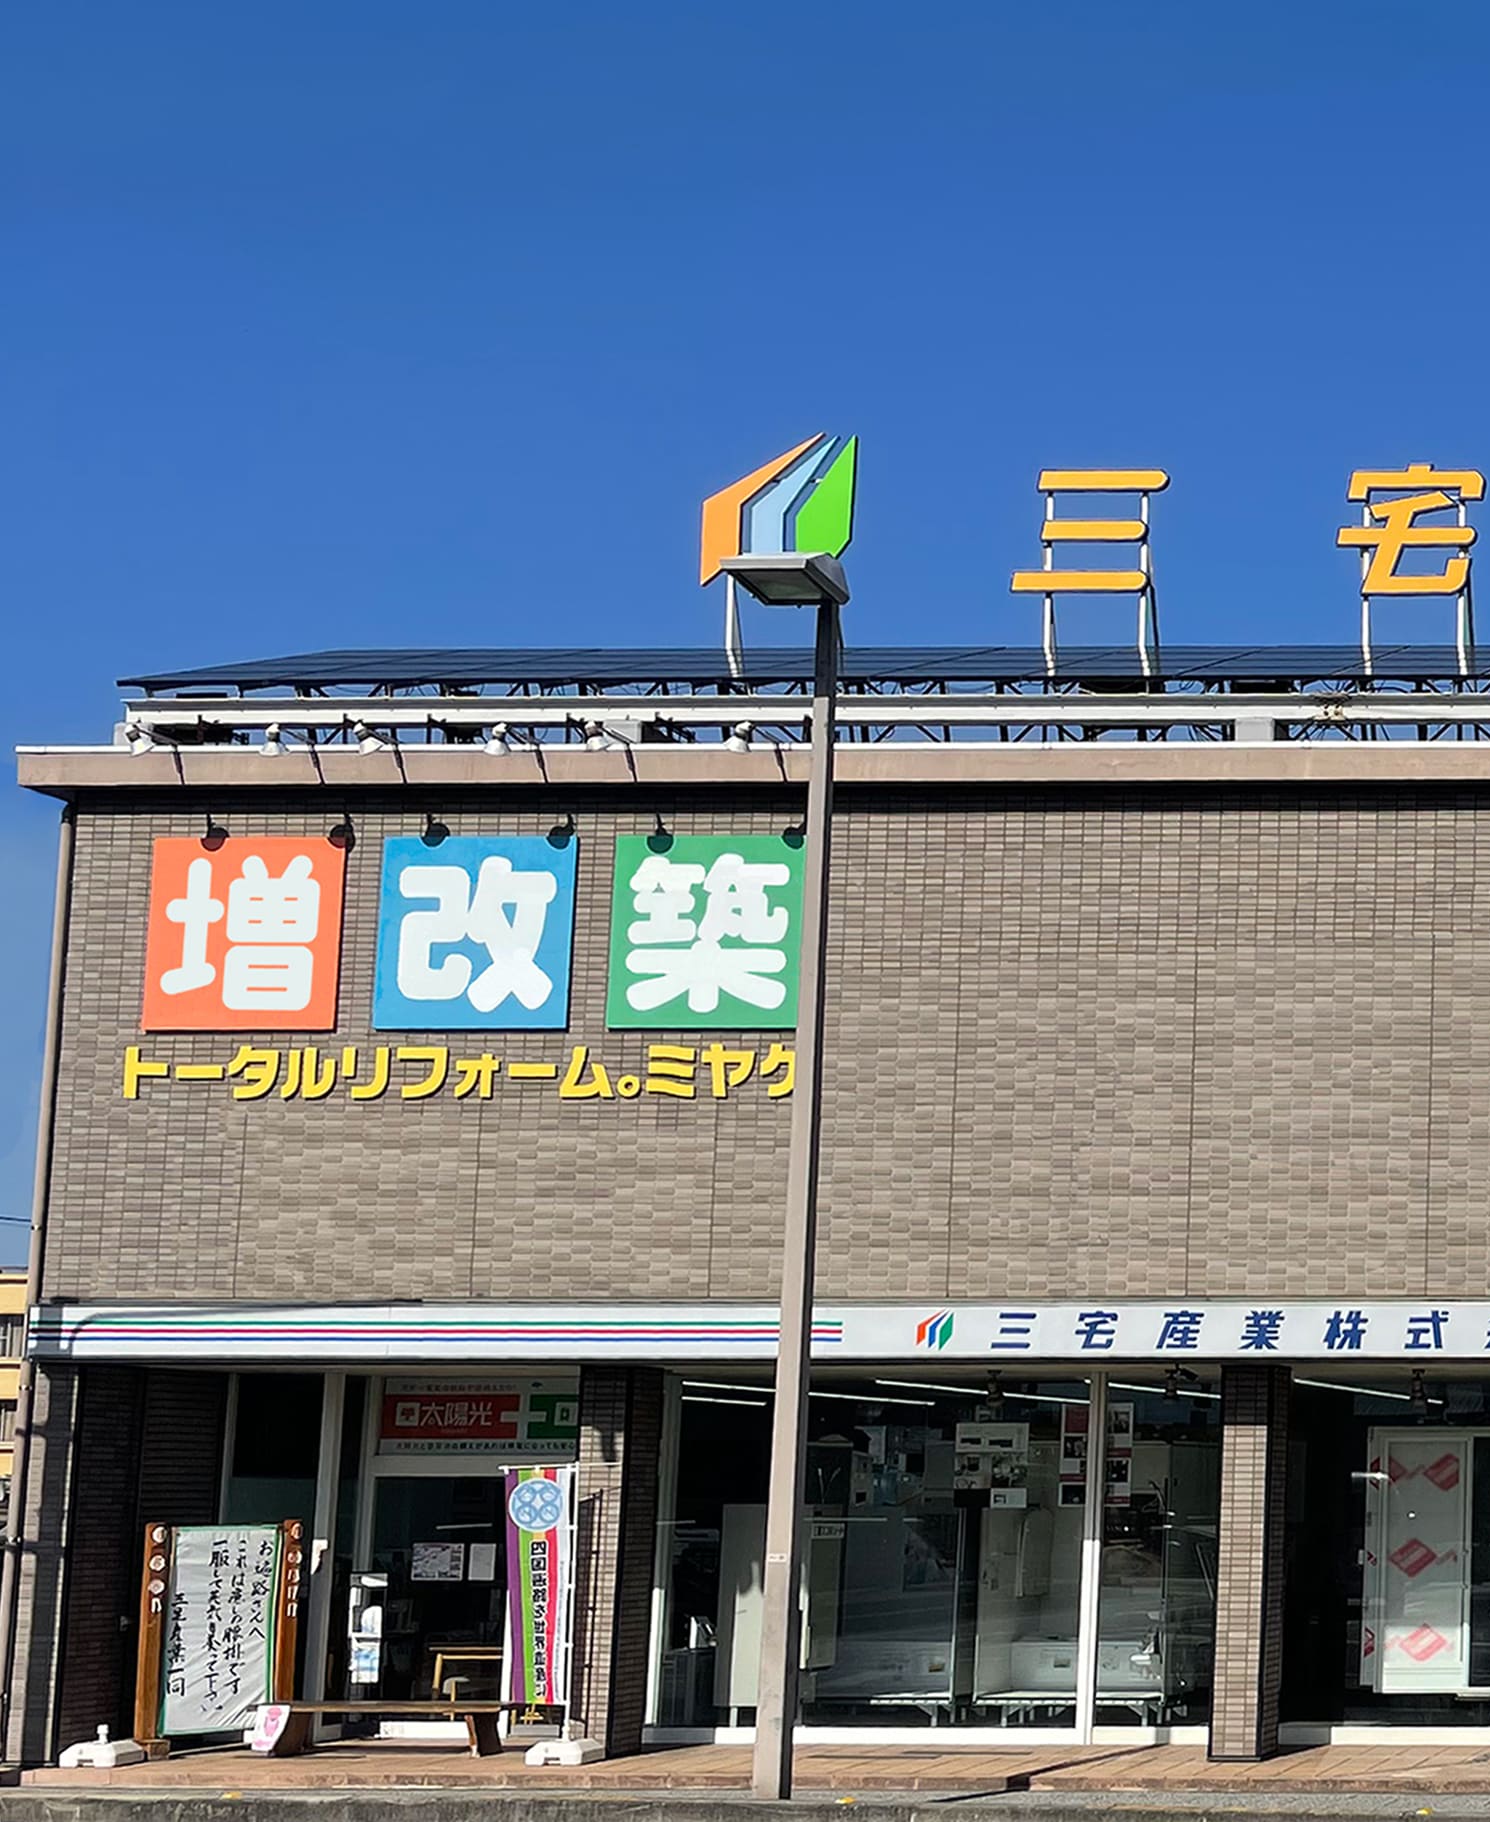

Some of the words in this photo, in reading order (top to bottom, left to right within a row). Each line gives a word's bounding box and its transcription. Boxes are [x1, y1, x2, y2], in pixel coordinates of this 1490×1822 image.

[160, 853, 791, 1013] 増改築
[420, 1402, 493, 1427] 太陽光
